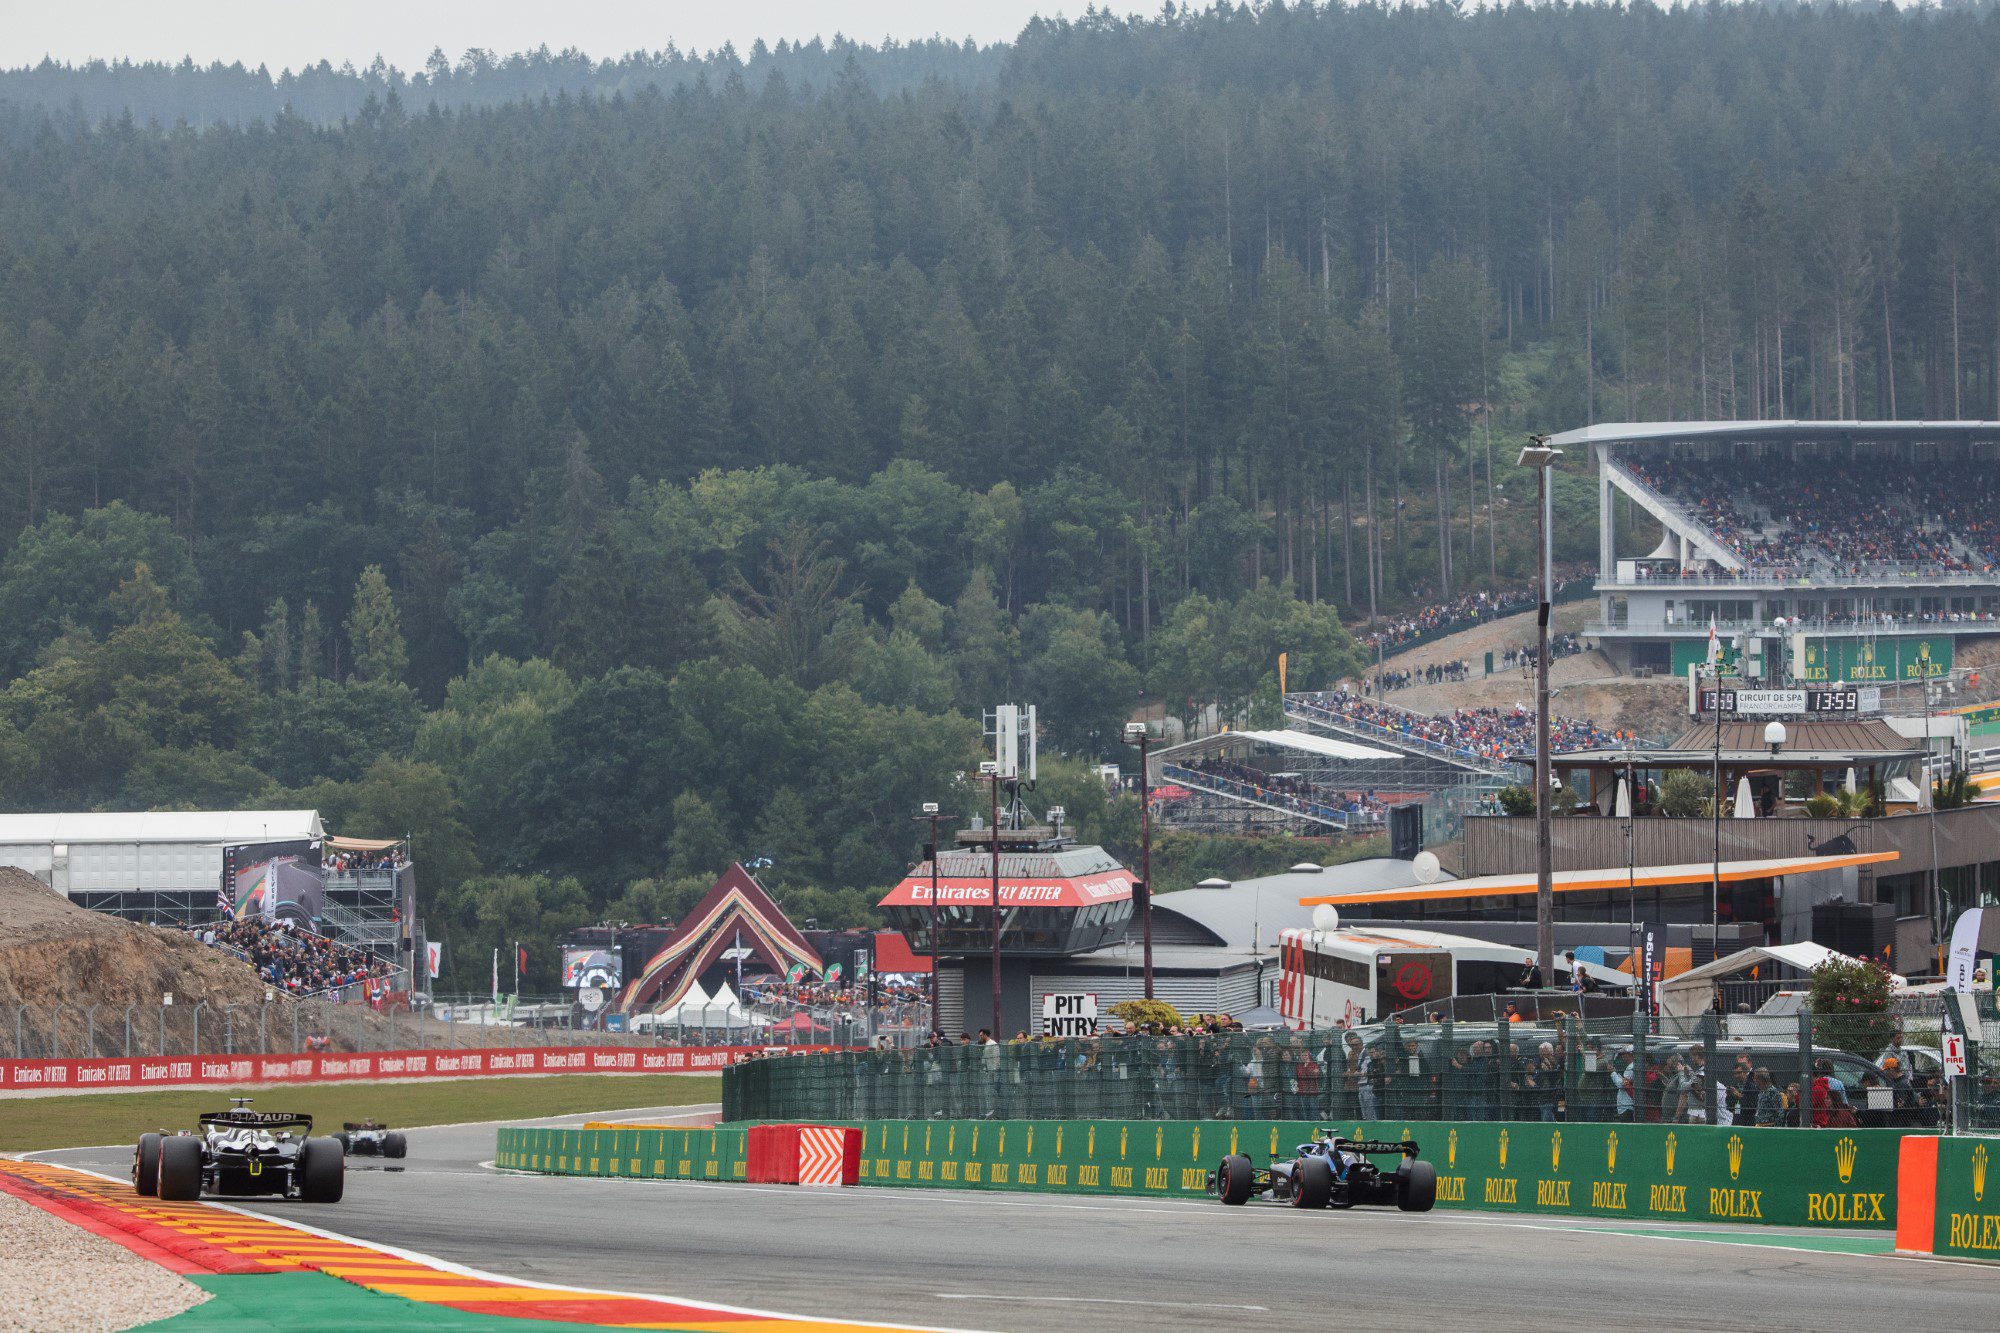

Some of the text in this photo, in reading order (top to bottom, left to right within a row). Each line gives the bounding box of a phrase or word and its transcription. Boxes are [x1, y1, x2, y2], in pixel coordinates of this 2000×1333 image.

[1851, 666, 1886, 678] ROLEX
[1907, 664, 1943, 677] ROLEX
[1739, 694, 1803, 702] CIRCUIT DE SPA
[1816, 692, 1857, 710] 13:59
[911, 885, 1062, 900] Emirates FLY BETTER
[1055, 995, 1085, 1015] PIT
[14, 1066, 42, 1082] Emirates
[78, 1066, 106, 1082] Emirates
[141, 1063, 168, 1080] Emirates
[1078, 1165, 1099, 1186] ROLEX
[1110, 1166, 1133, 1188] ROLEX
[1145, 1167, 1168, 1189] ROLEX
[1182, 1168, 1207, 1190] ROLEX
[1435, 1176, 1466, 1201] ROLEX
[1485, 1177, 1518, 1203] ROLEX
[1537, 1180, 1571, 1206] ROLEX
[1592, 1181, 1627, 1209] ROLEX
[1649, 1184, 1686, 1212] ROLEX
[1709, 1187, 1762, 1218] ROLEX
[1808, 1193, 1885, 1221] ROLEX
